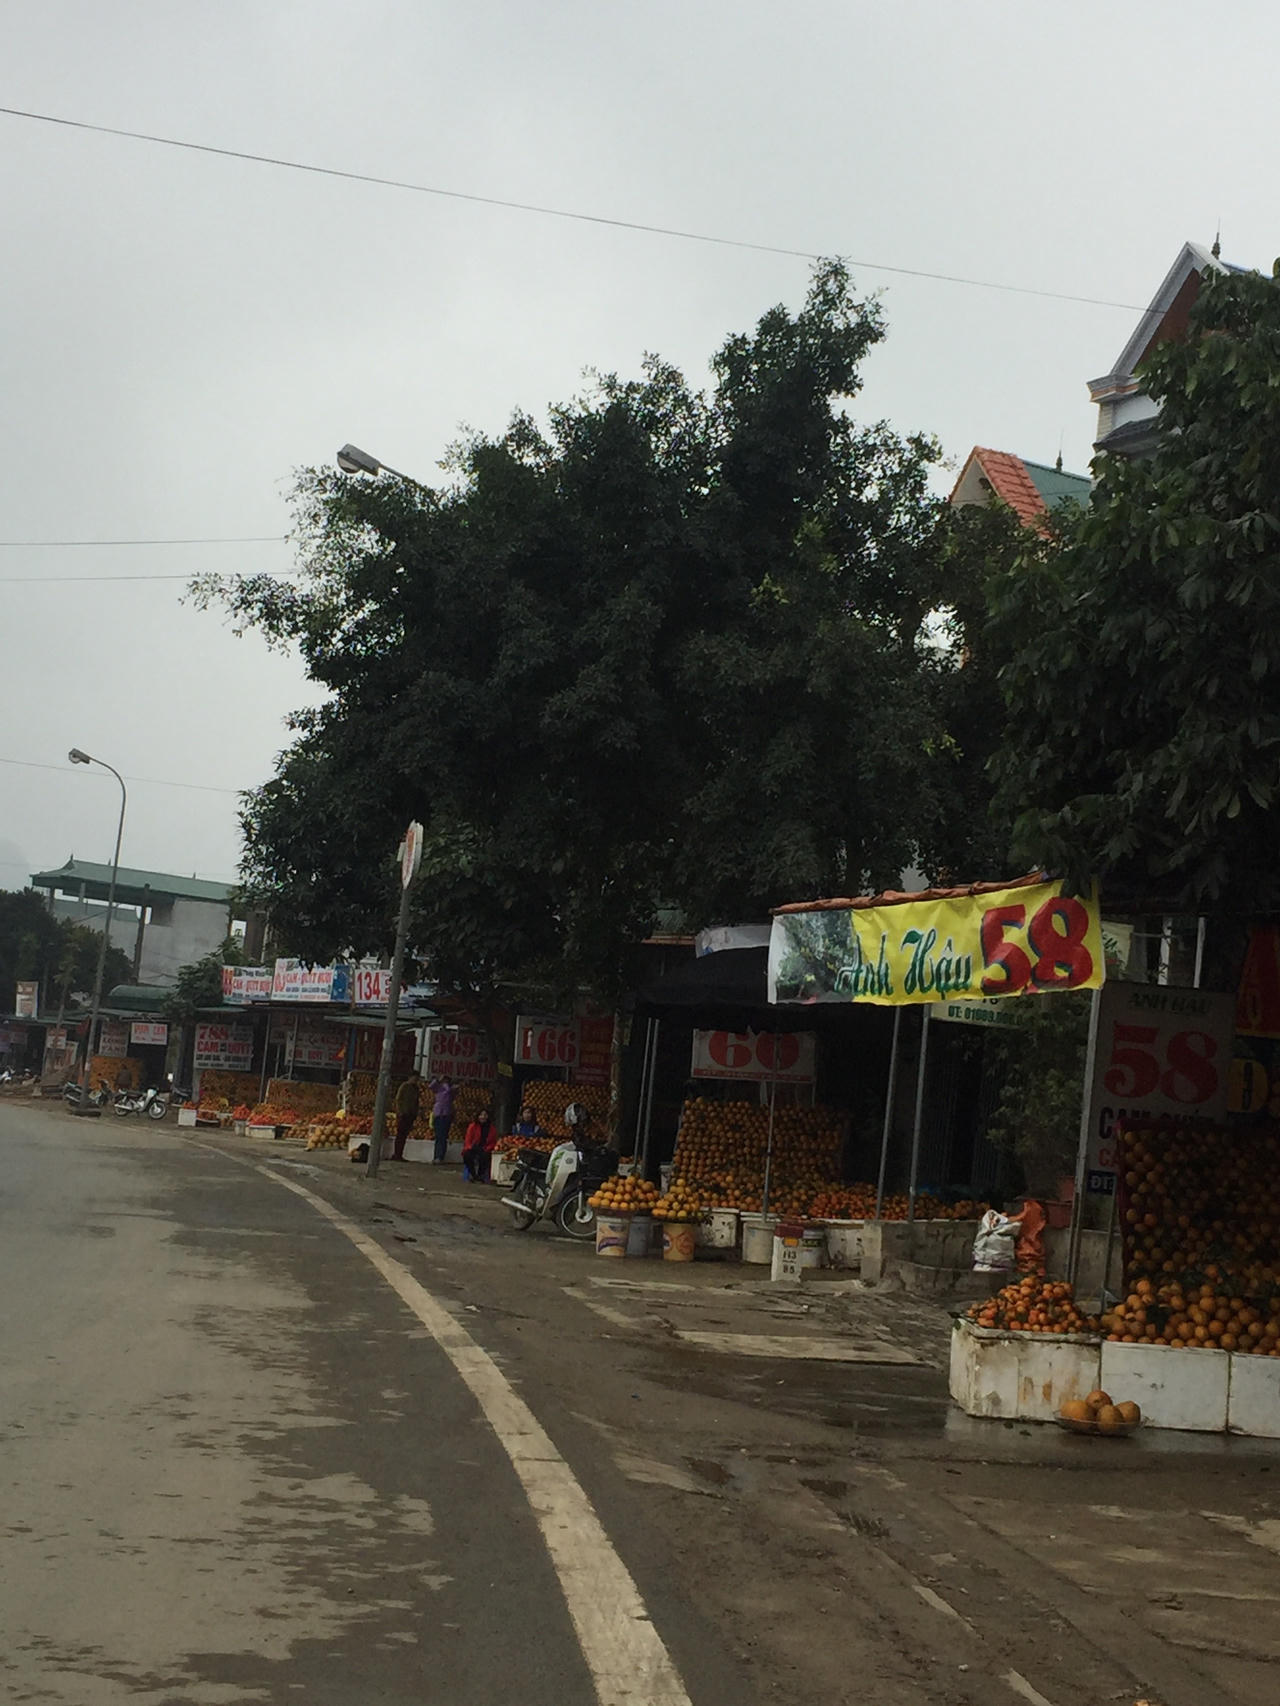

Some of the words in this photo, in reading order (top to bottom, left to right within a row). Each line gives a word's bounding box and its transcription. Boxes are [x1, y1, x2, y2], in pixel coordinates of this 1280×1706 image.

[834, 933, 894, 996] Anh
[901, 928, 971, 1000] Hậu
[980, 897, 1093, 995] 58
[357, 971, 381, 1000] 134
[432, 1033, 478, 1057] 369
[521, 1026, 577, 1062] 166
[431, 1060, 454, 1074] CAM
[1103, 1021, 1218, 1104] 58
